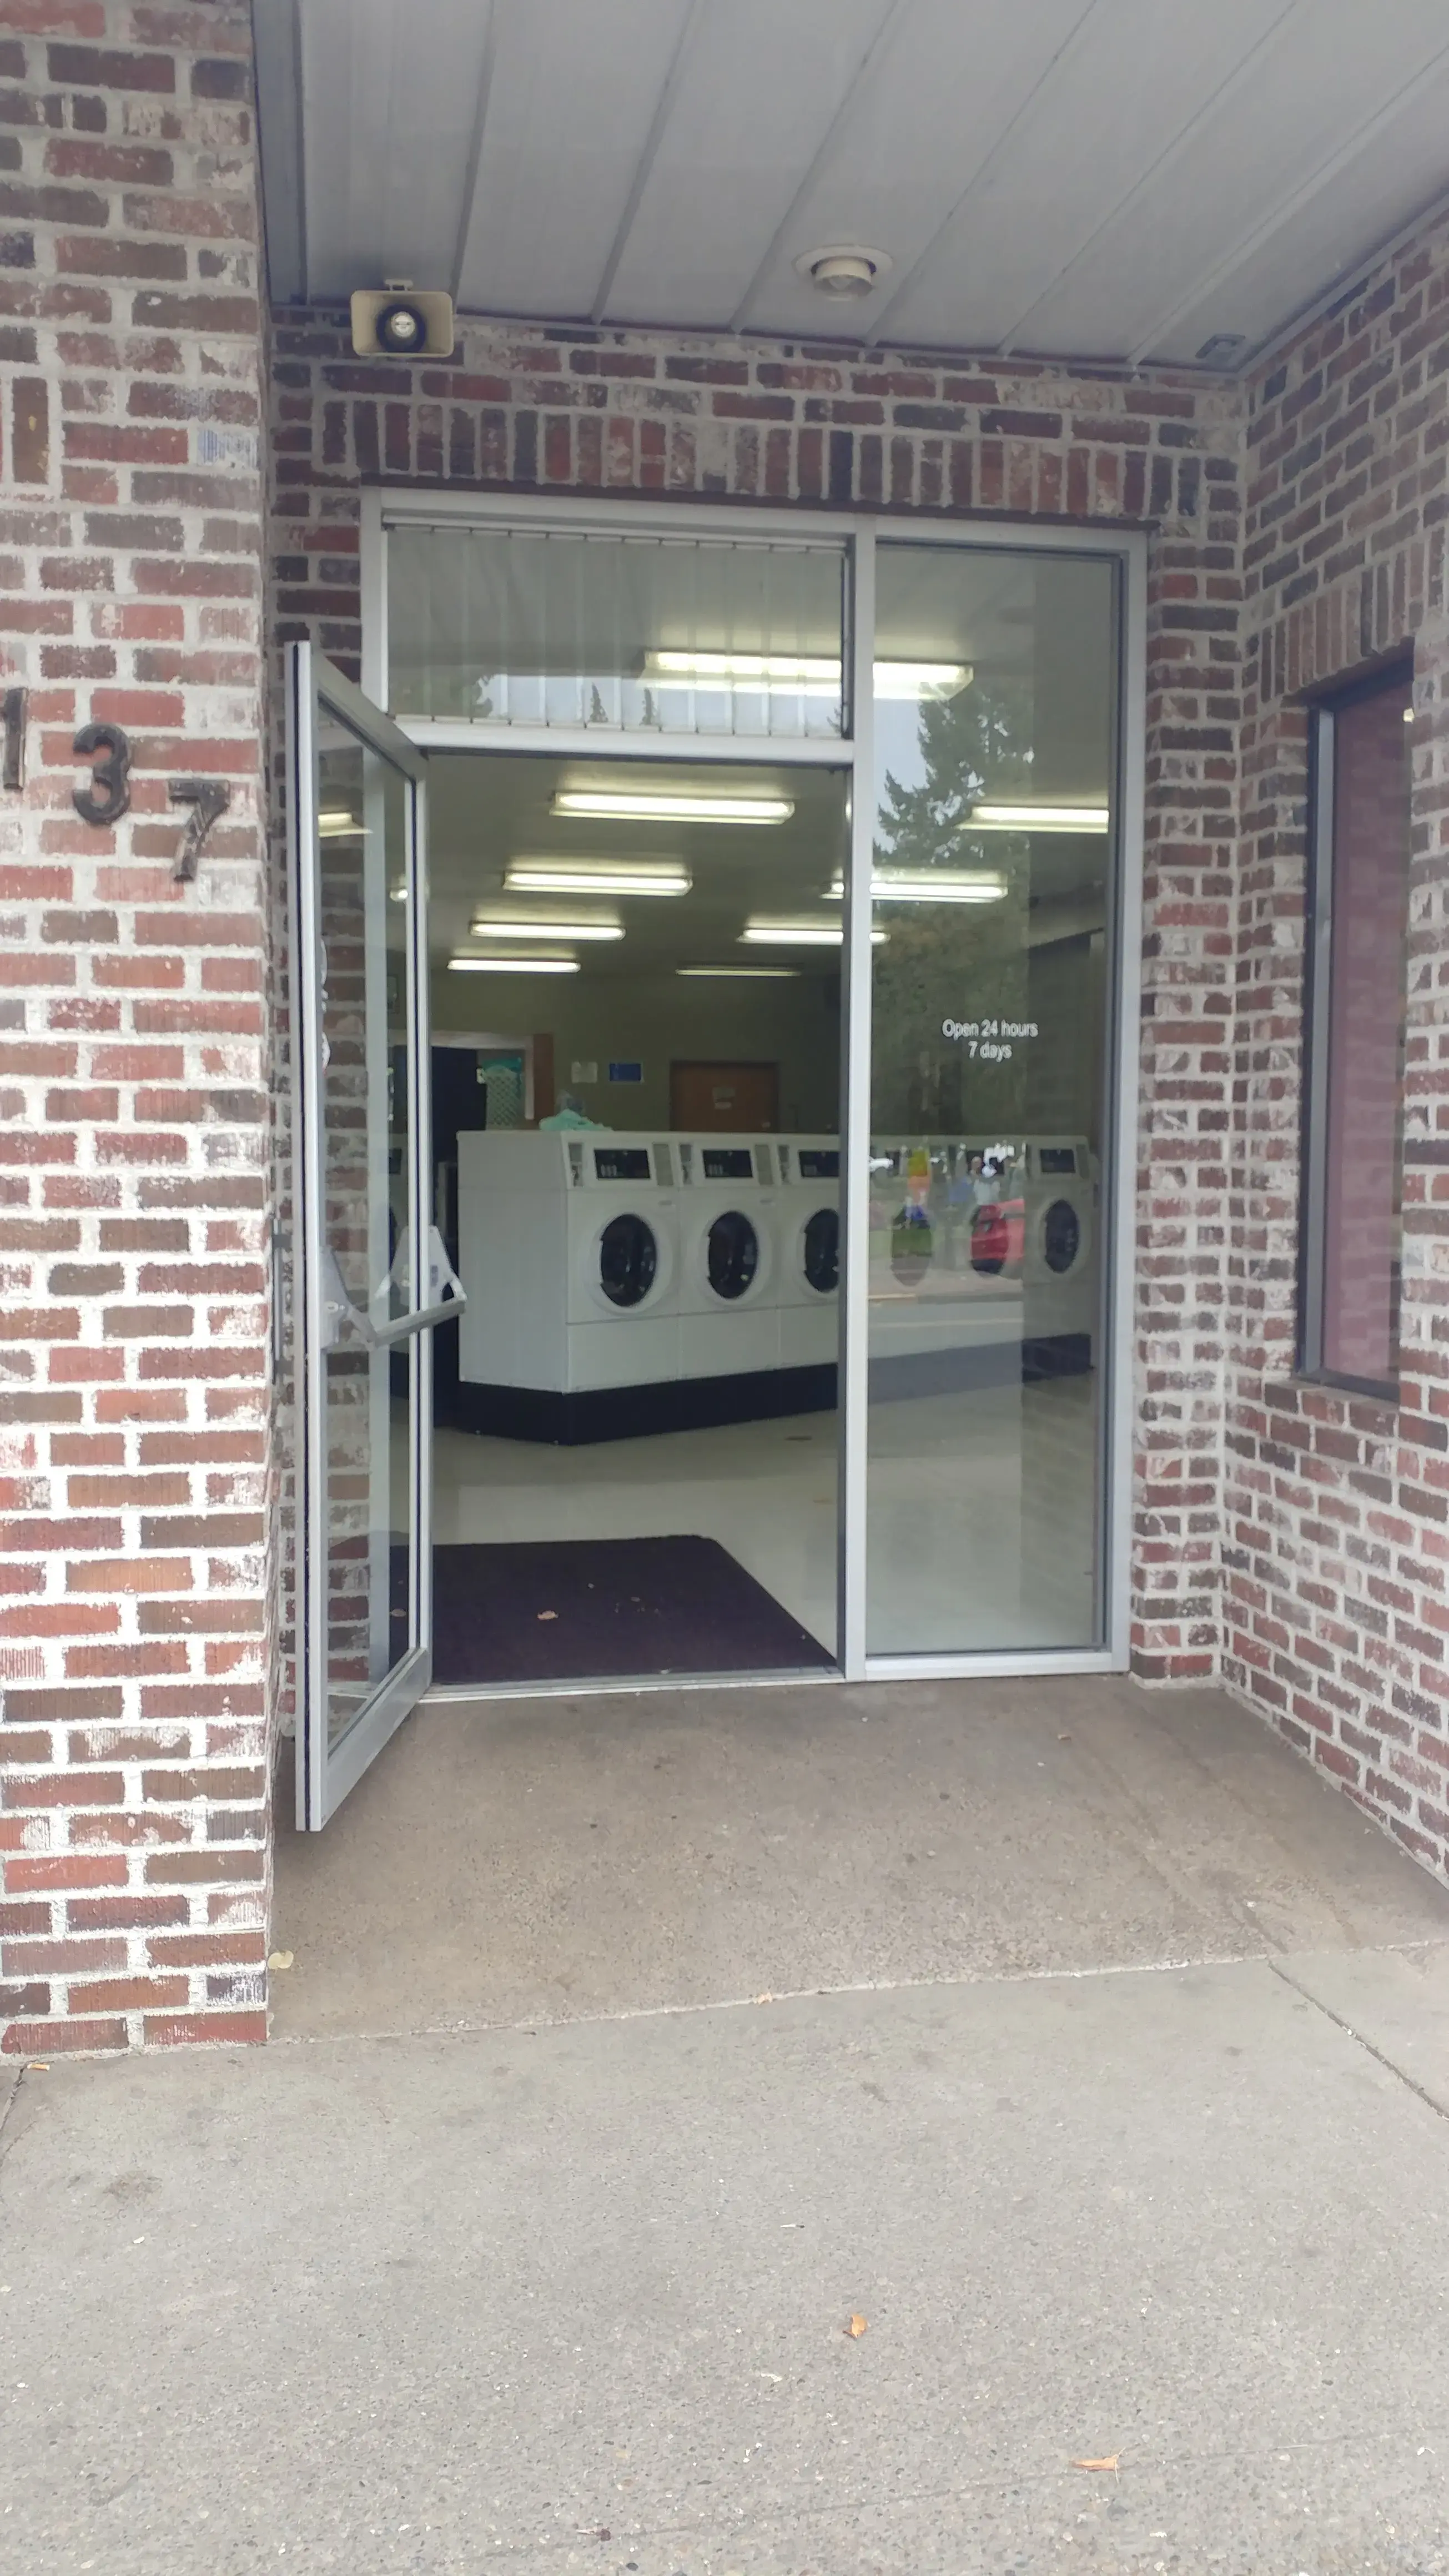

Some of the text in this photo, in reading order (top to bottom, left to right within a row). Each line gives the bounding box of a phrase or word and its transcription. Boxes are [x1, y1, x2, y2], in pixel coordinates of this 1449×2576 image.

[942, 1019, 1038, 1040] Open 24 hours
[968, 1041, 1012, 1062] 7 days
